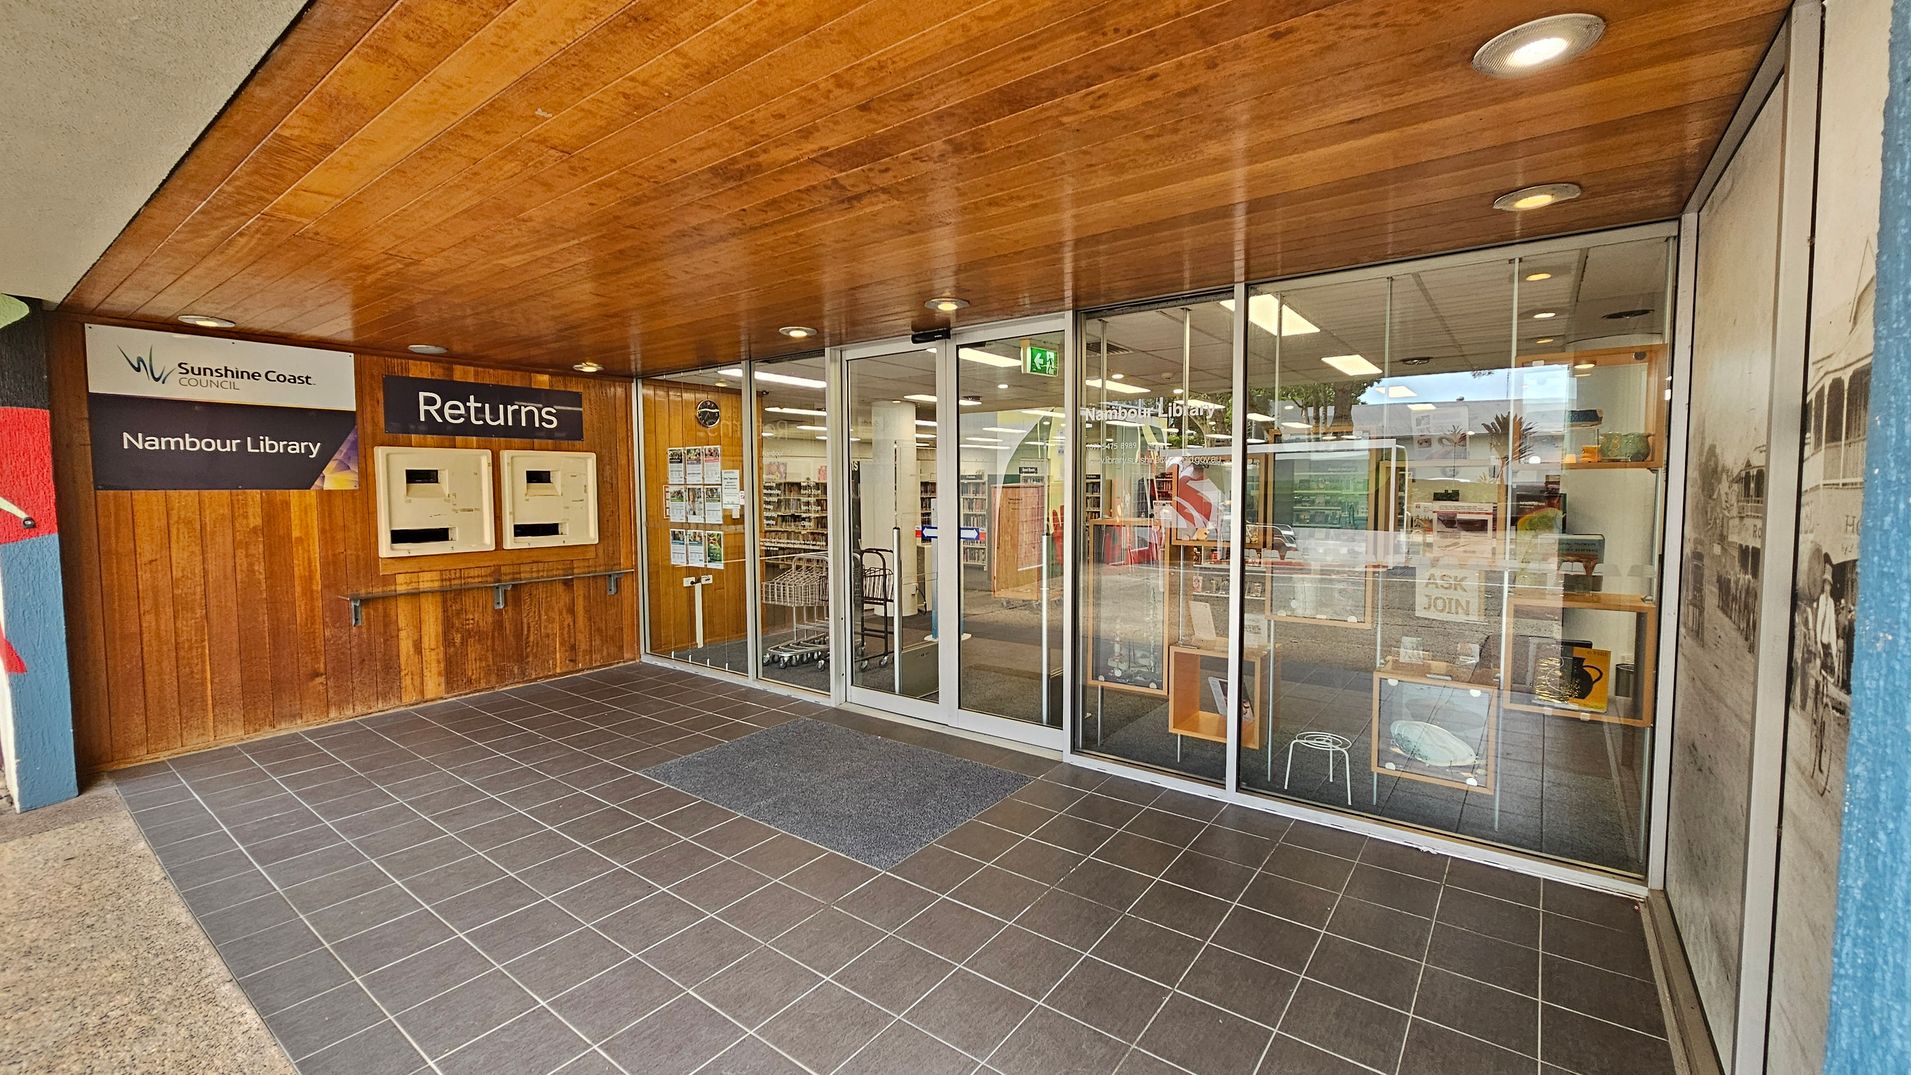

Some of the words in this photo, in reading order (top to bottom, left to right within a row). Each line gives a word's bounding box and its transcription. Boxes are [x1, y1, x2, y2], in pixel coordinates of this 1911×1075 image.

[177, 362, 262, 381] Sunshine
[264, 370, 313, 386] Coast
[178, 377, 240, 390] COUNCIL
[418, 391, 558, 430] Returns
[1085, 406, 1151, 421] Nambour
[1158, 402, 1215, 419] Library
[122, 431, 241, 452] Nambour
[247, 436, 321, 458] Library
[1424, 573, 1469, 592] ASK
[1423, 594, 1470, 615] JOIN
